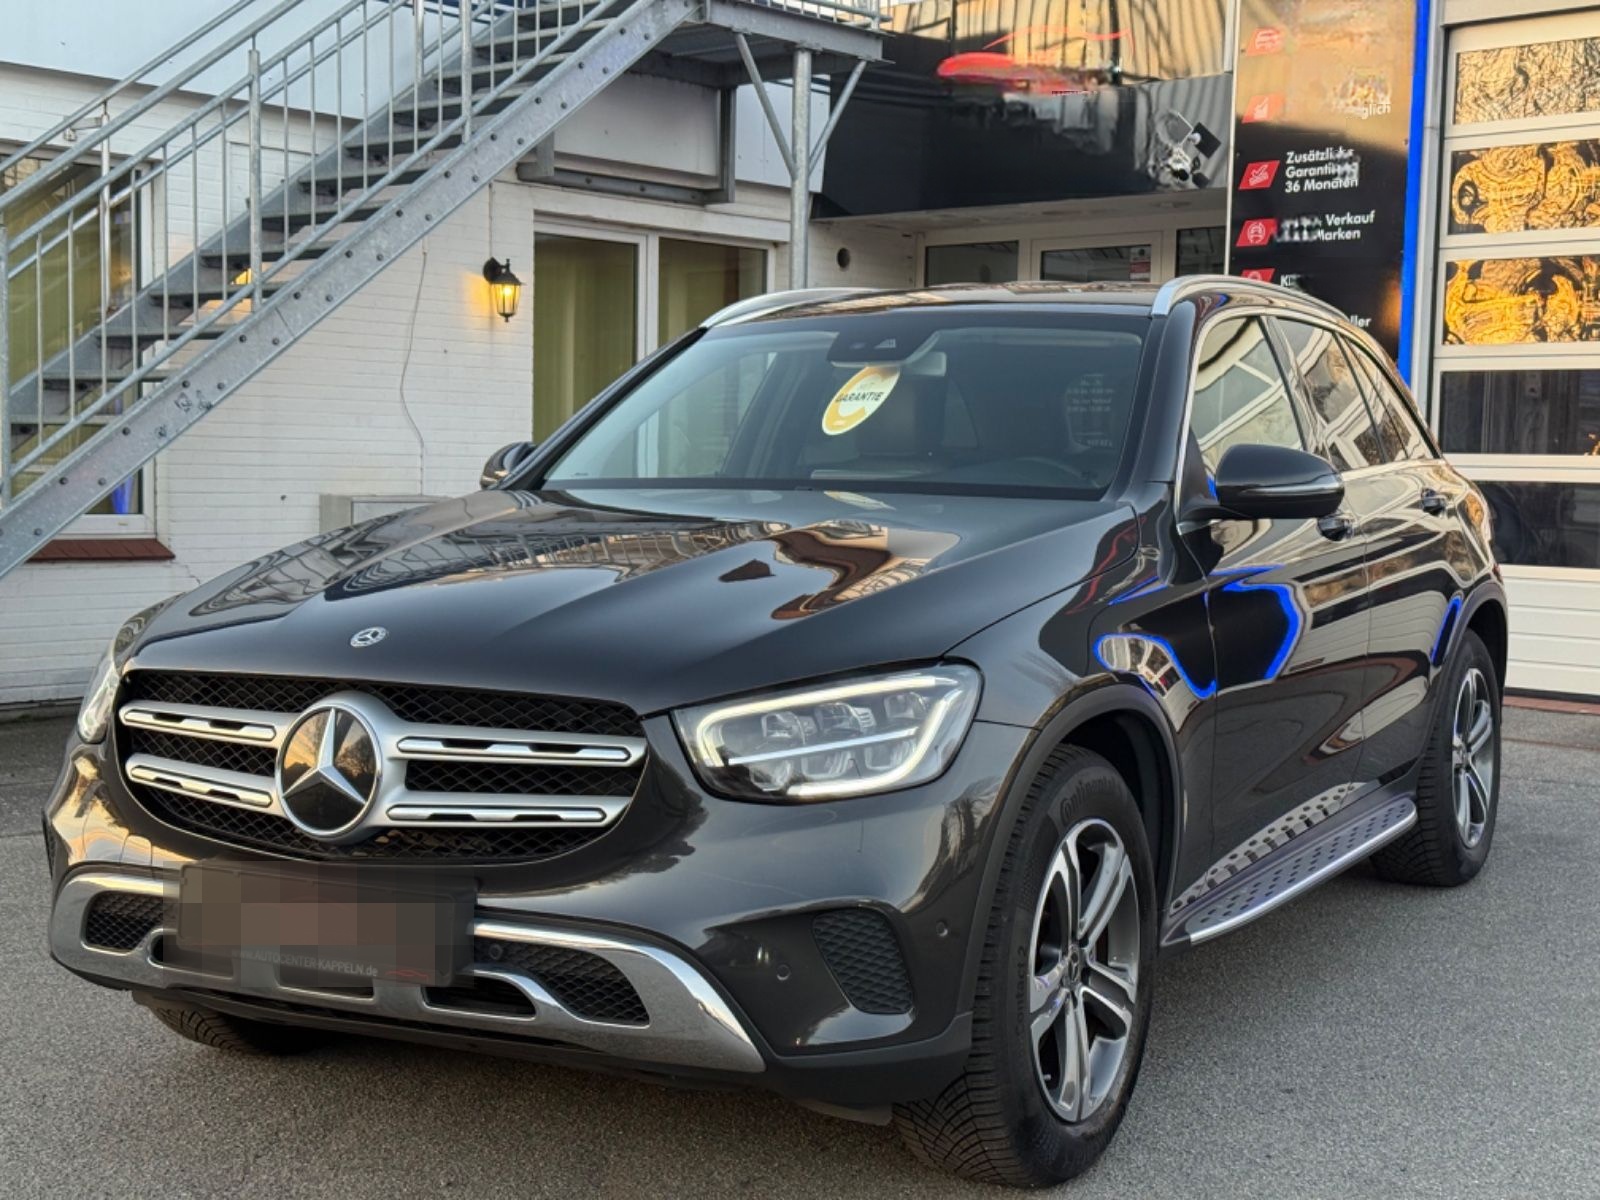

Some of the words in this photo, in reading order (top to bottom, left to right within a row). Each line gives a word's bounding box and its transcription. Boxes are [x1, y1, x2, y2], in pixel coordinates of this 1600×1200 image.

[1285, 180, 1300, 193] 36
[1303, 177, 1358, 191] Monaten
[1325, 209, 1375, 226] Verkauf
